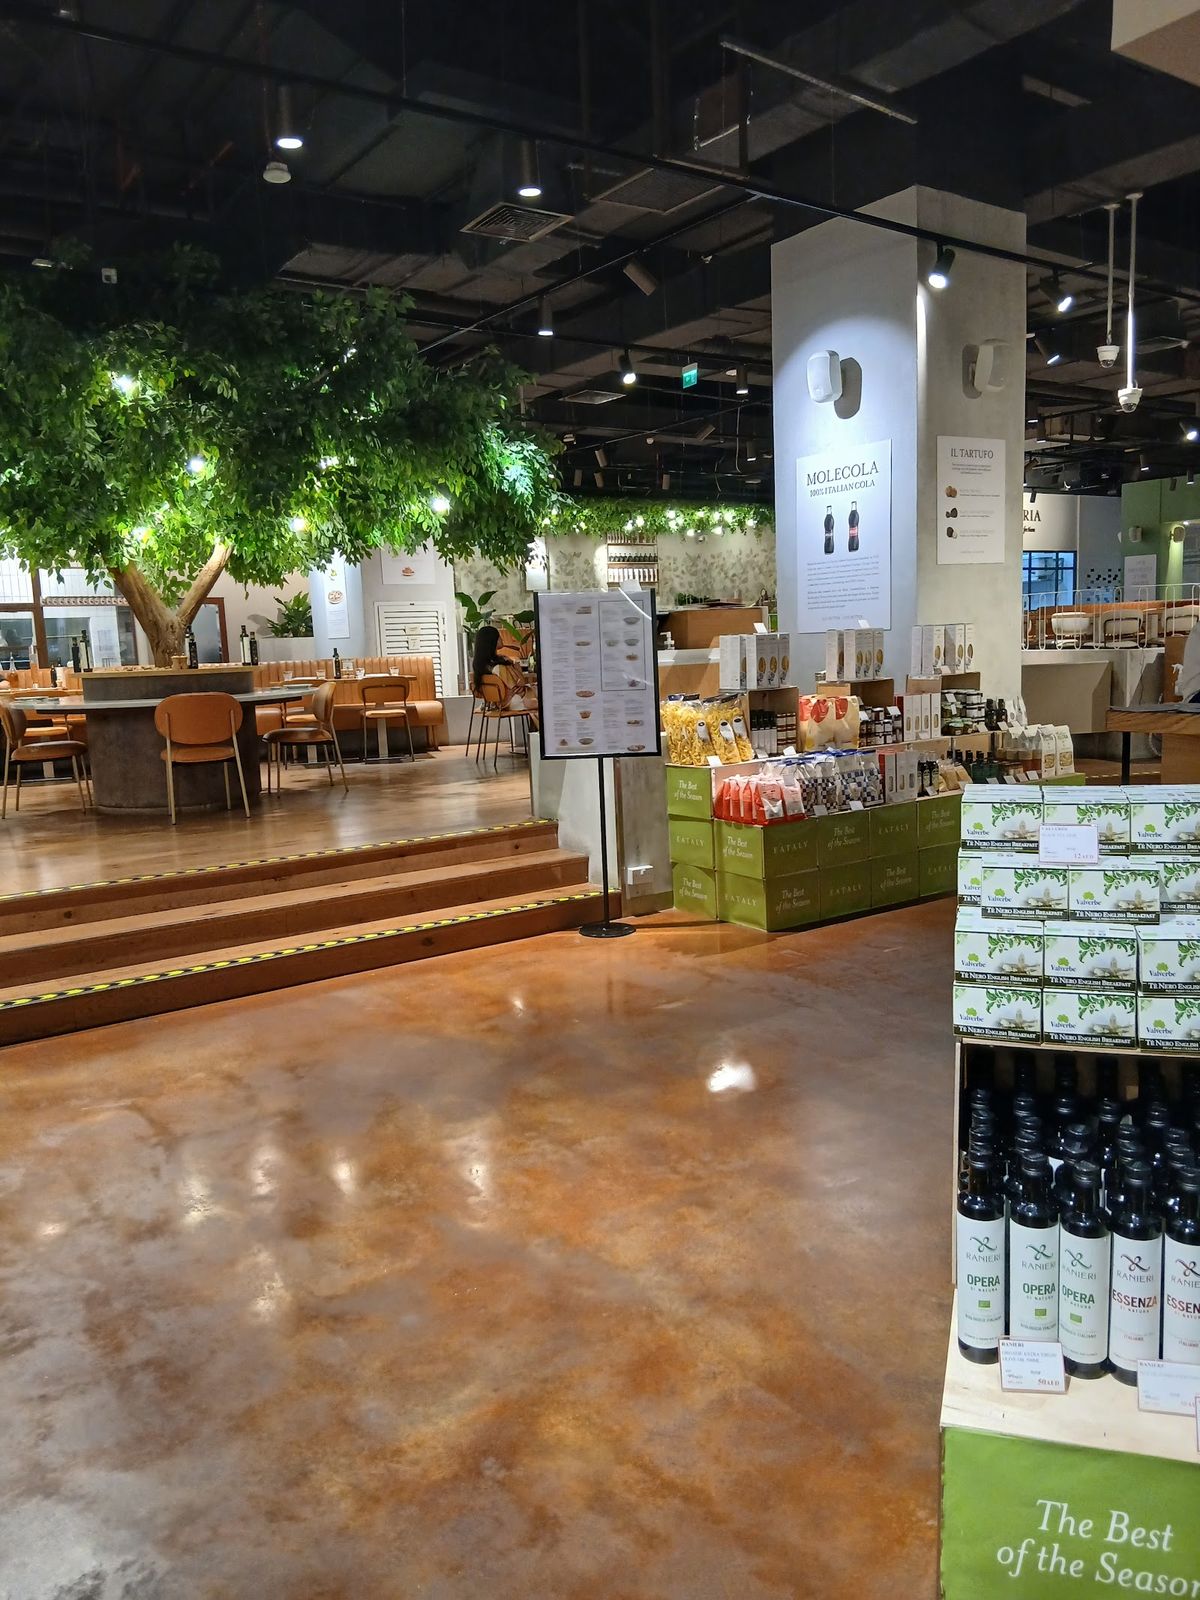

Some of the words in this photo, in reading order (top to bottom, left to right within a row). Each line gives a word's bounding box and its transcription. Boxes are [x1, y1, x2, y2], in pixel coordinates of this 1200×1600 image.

[950, 448, 958, 457] IL
[960, 448, 994, 459] TARTUFO
[806, 461, 879, 486] MOLECOLA
[824, 483, 854, 495] ITALIAN
[854, 480, 876, 489] COLA
[678, 780, 687, 789] The
[687, 781, 698, 790] Best
[674, 791, 680, 801] of
[676, 836, 705, 847] EATALY
[727, 836, 736, 845] The
[737, 838, 748, 848] Best
[723, 847, 728, 857] of
[727, 848, 736, 856] the
[683, 878, 691, 888] The
[692, 880, 702, 889] Best
[679, 887, 685, 896] of
[725, 895, 757, 906] EATALY
[967, 1274, 1000, 1287] OPERA
[1116, 1270, 1154, 1283] RANIERI
[1023, 1282, 1056, 1295] OPERA
[1062, 1285, 1095, 1304] OPERA
[1112, 1289, 1157, 1308] ESSENZA
[1036, 1499, 1093, 1538] The
[1104, 1510, 1173, 1552] Best
[997, 1538, 1035, 1577] of
[1037, 1544, 1084, 1577] the
